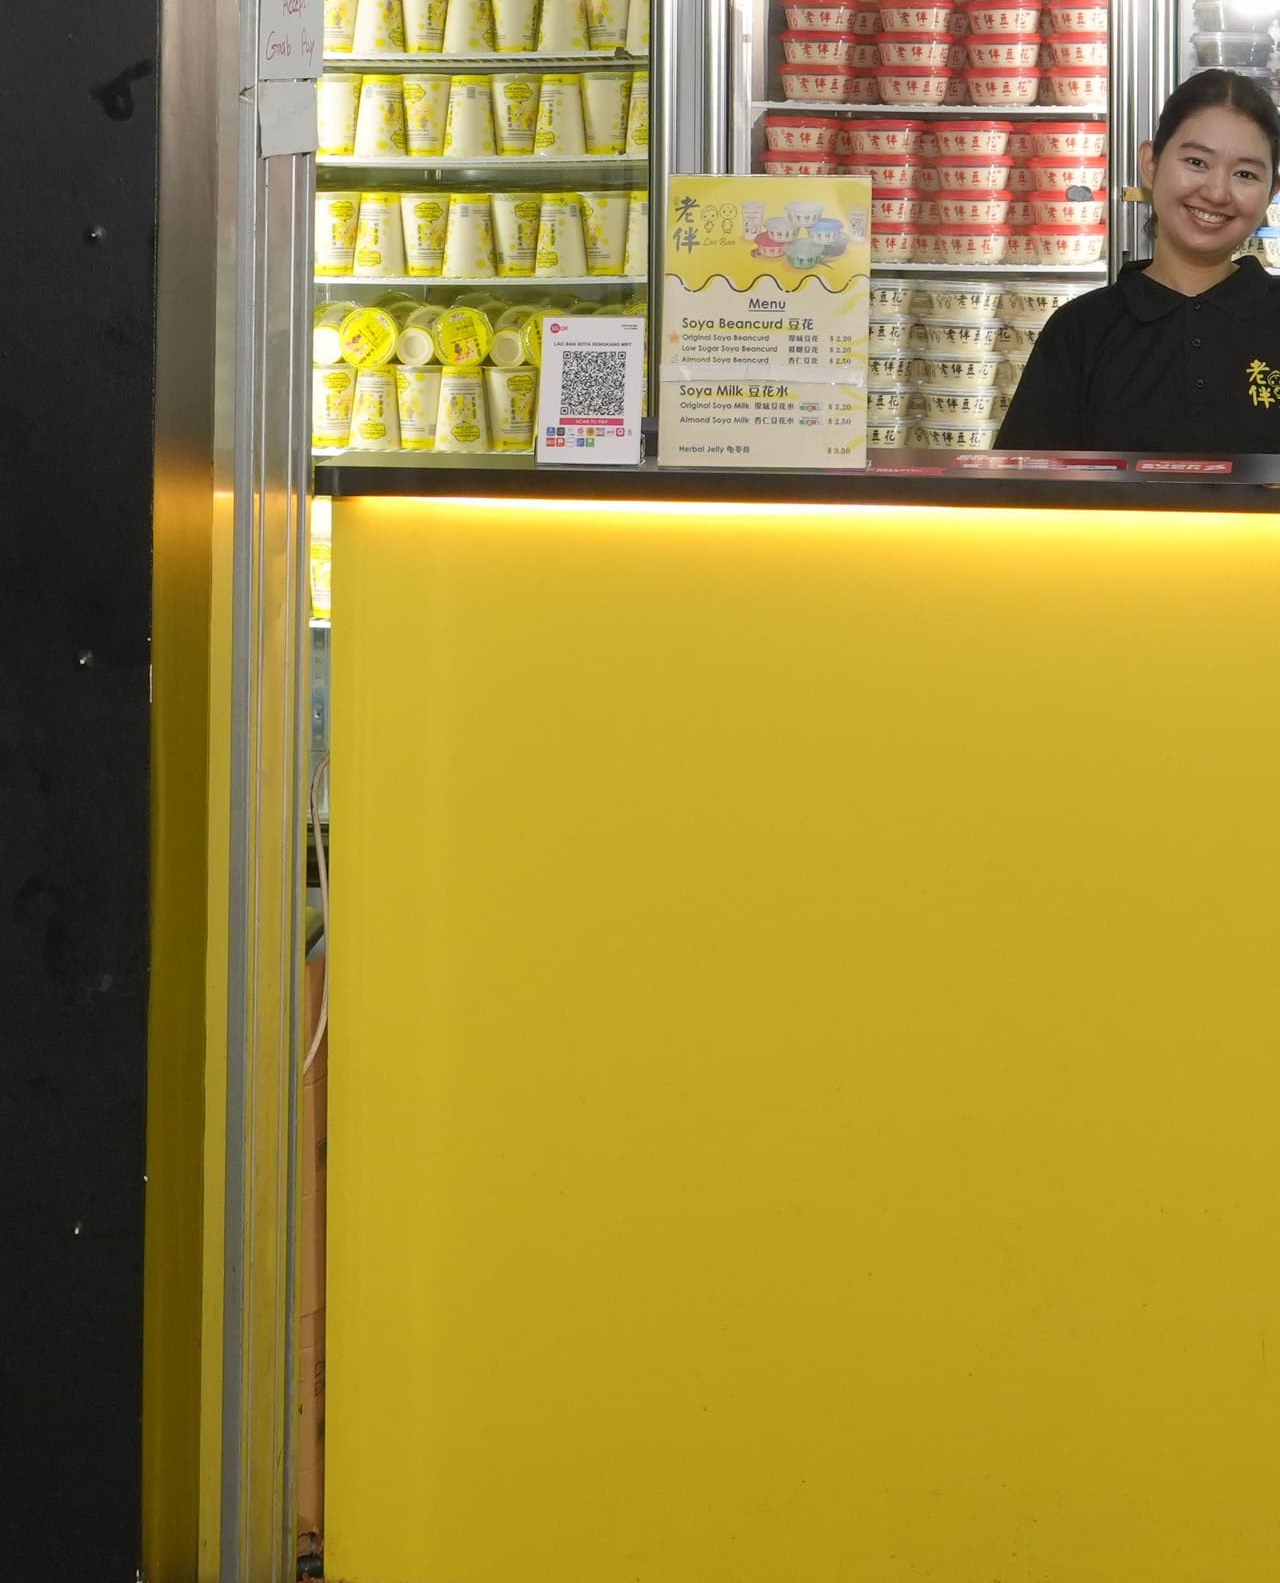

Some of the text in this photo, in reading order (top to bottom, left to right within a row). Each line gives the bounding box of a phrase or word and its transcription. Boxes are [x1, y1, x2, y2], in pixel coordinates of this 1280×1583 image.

[673, 196, 700, 254] 老伴
[749, 298, 786, 309] Menu
[682, 318, 814, 331] Soya Beancurd 豆花
[682, 334, 711, 342] Original
[713, 334, 732, 342] Soya
[733, 334, 769, 342] Beancurd
[1246, 359, 1275, 409] 老伴
[680, 385, 788, 399] Soya Milk 豆花水
[680, 402, 711, 410] Original
[712, 417, 732, 425] Soya
[707, 446, 724, 454] Jelly
